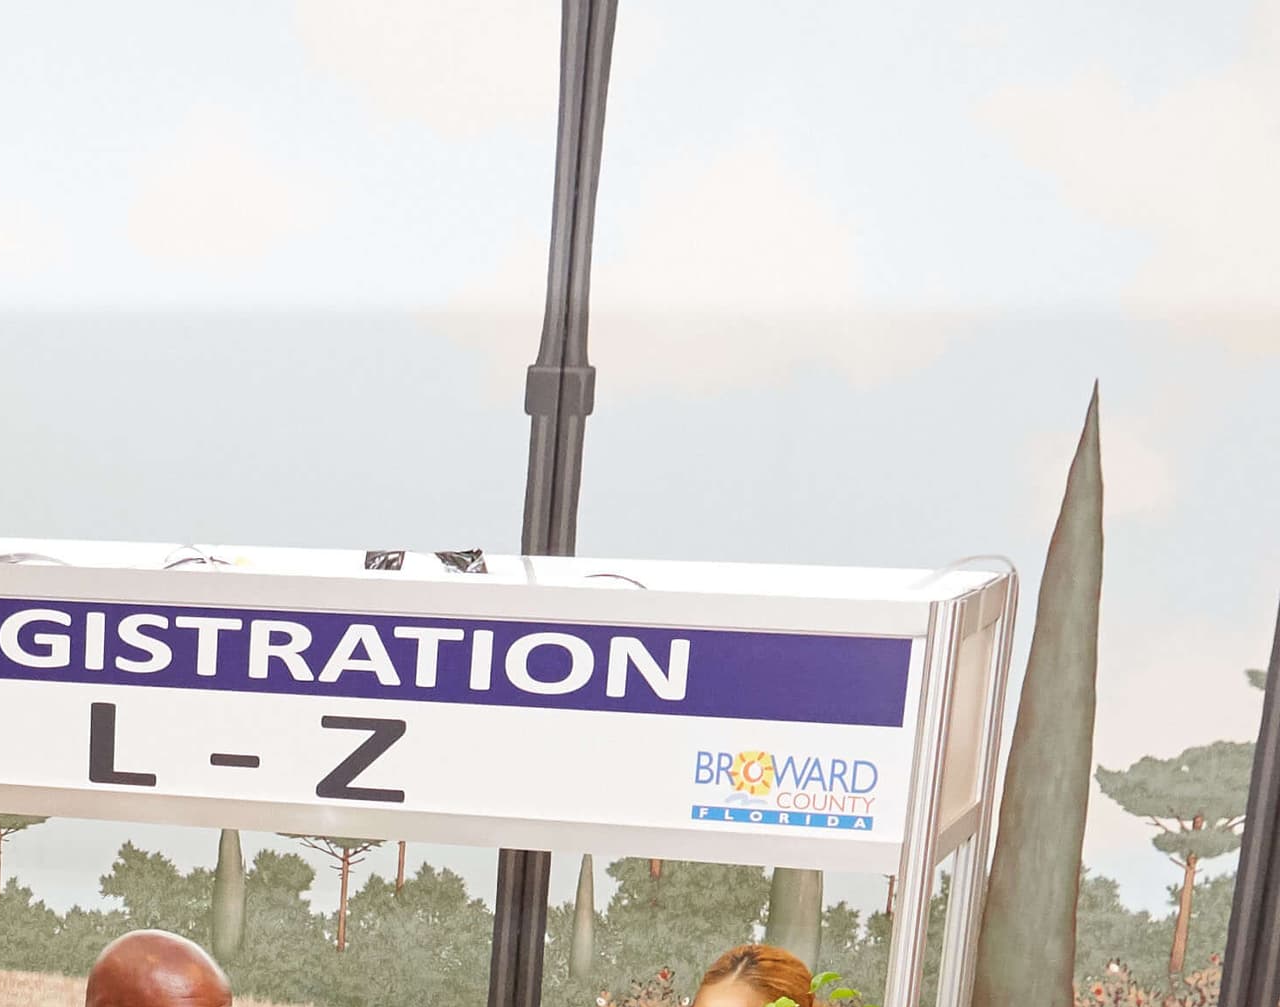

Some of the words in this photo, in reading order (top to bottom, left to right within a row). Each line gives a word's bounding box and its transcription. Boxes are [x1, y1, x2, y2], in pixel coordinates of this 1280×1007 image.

[89, 702, 157, 787] L
[315, 715, 407, 803] Z
[695, 751, 878, 794] BROWARD
[699, 807, 867, 829] FLORIDA
[777, 792, 876, 814] COUNTY
